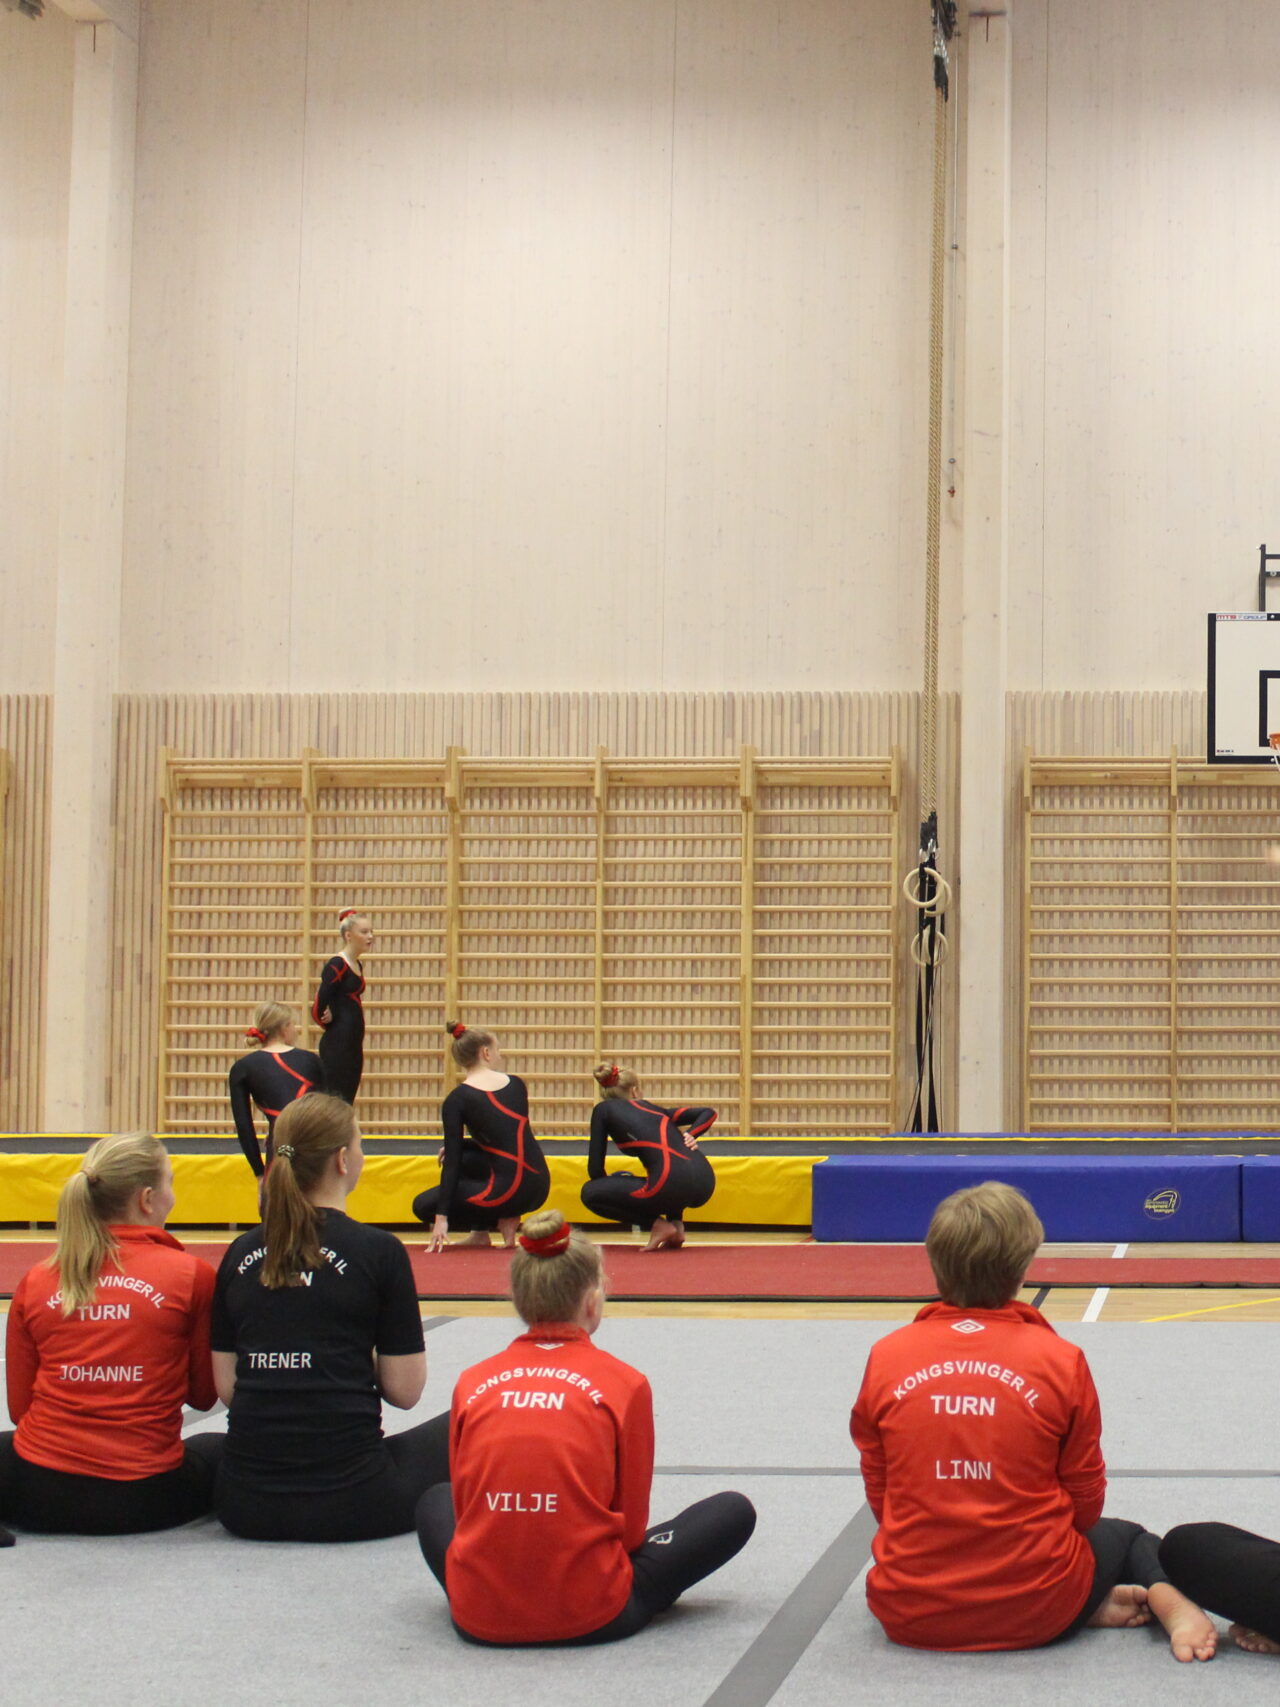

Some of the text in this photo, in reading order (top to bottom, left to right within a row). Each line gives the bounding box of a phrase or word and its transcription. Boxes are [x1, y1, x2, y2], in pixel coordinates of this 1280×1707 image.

[334, 1258, 348, 1276] IL
[46, 1275, 166, 1309] KOVINGER IL
[77, 1303, 131, 1321] TURN
[248, 1352, 312, 1369] TRENER
[59, 1364, 145, 1382] JOHANNE
[893, 1360, 1040, 1409] KONGSVINGER IL
[500, 1390, 566, 1411] TURN
[588, 1389, 605, 1406] IL
[930, 1394, 996, 1417] TURN
[935, 1460, 992, 1481] LINN
[485, 1491, 558, 1513] VILJE
